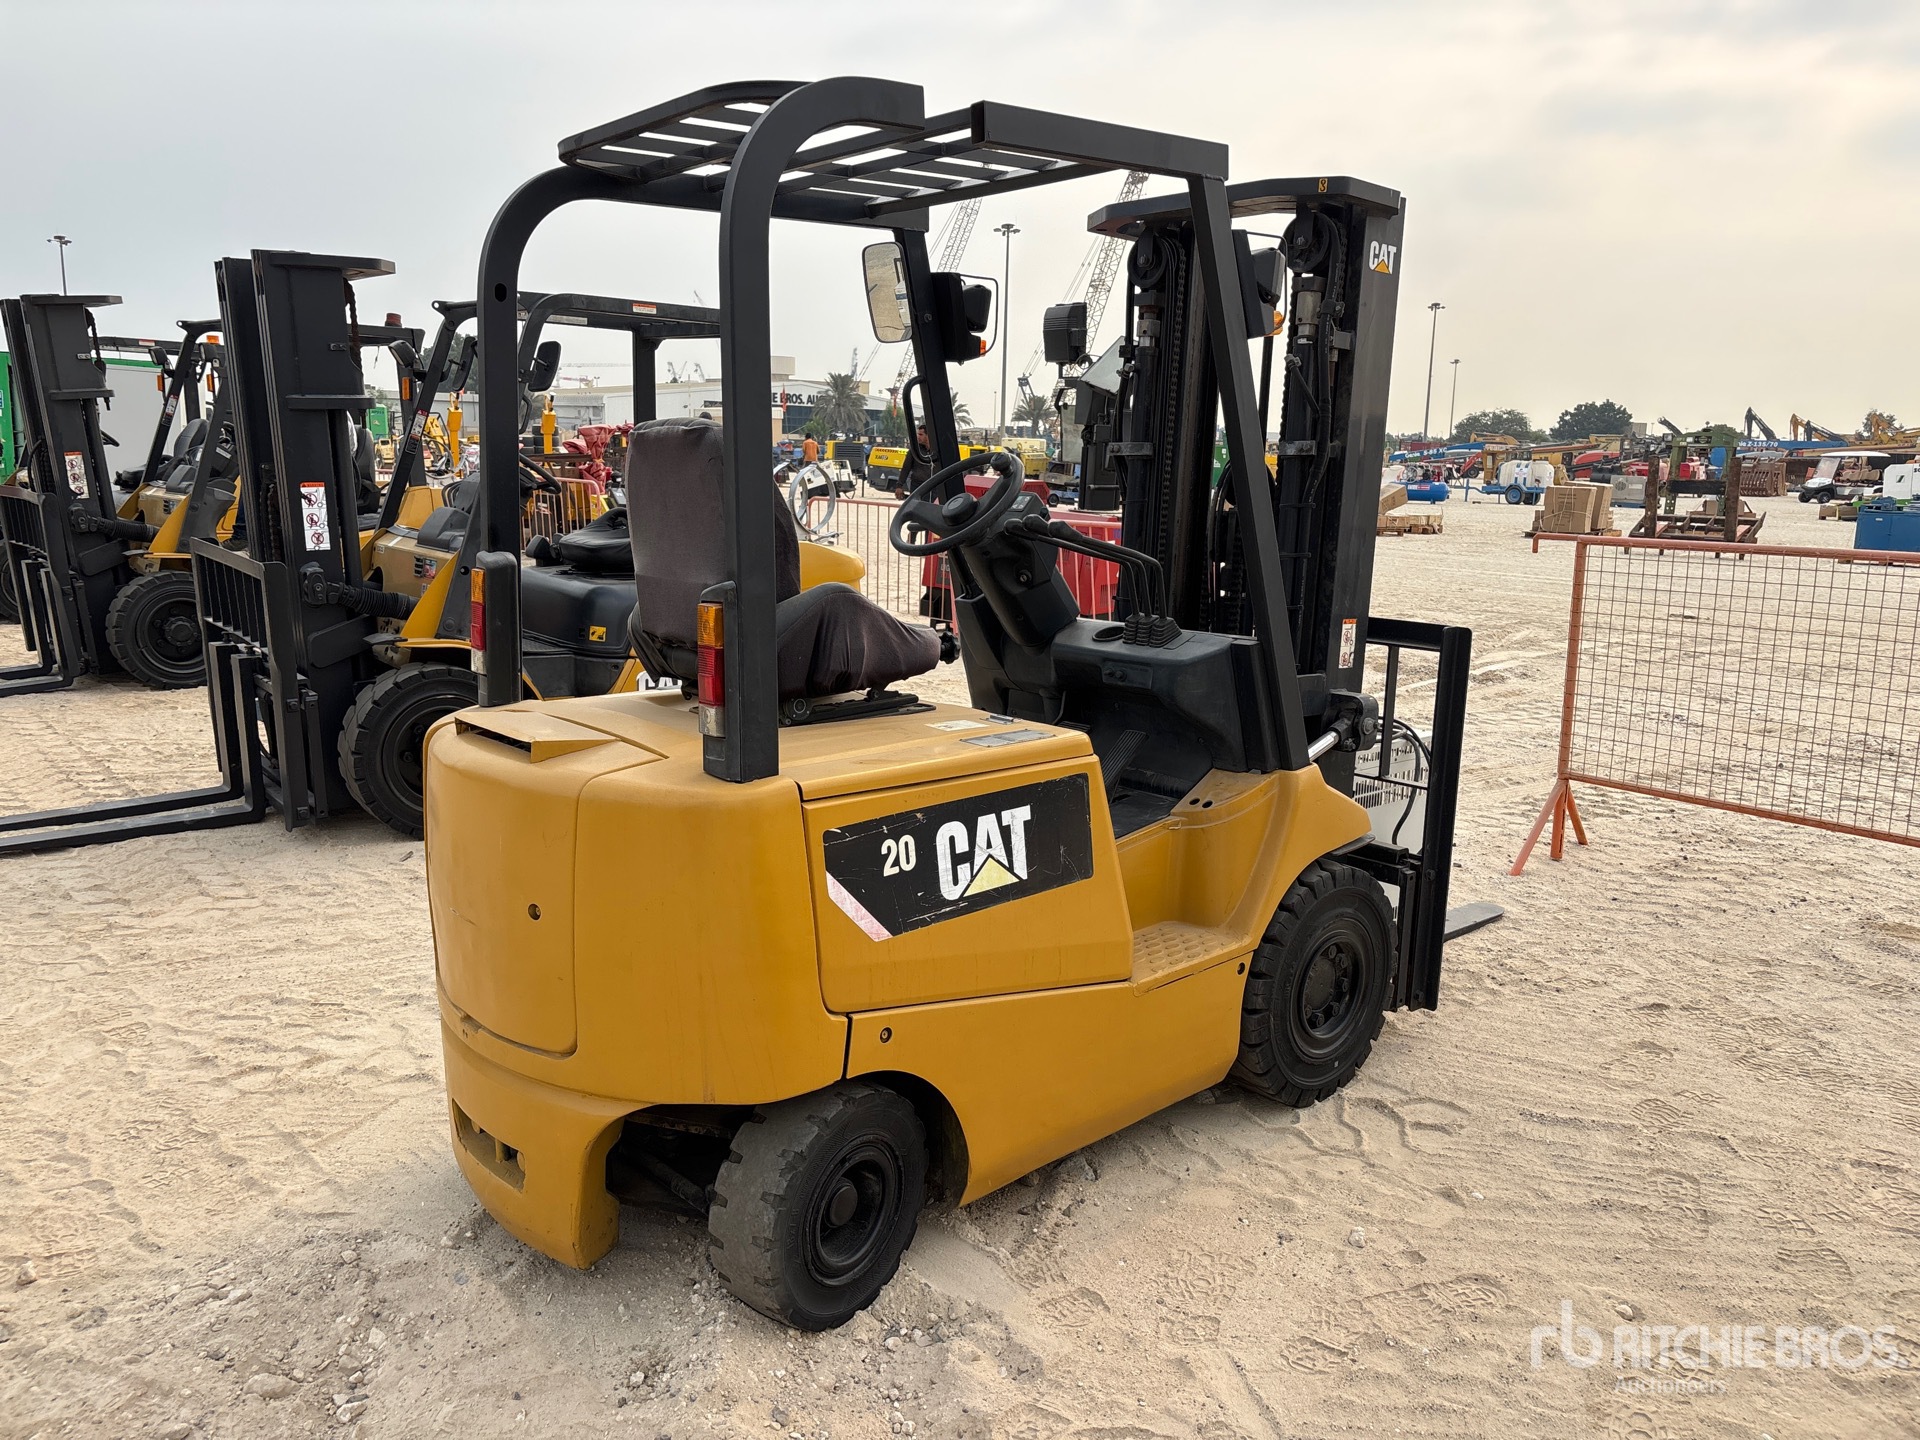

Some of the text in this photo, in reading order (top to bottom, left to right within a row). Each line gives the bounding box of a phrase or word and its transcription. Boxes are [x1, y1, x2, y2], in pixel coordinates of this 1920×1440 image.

[1369, 240, 1397, 275] CAT
[881, 804, 1032, 901] 20 CAT
